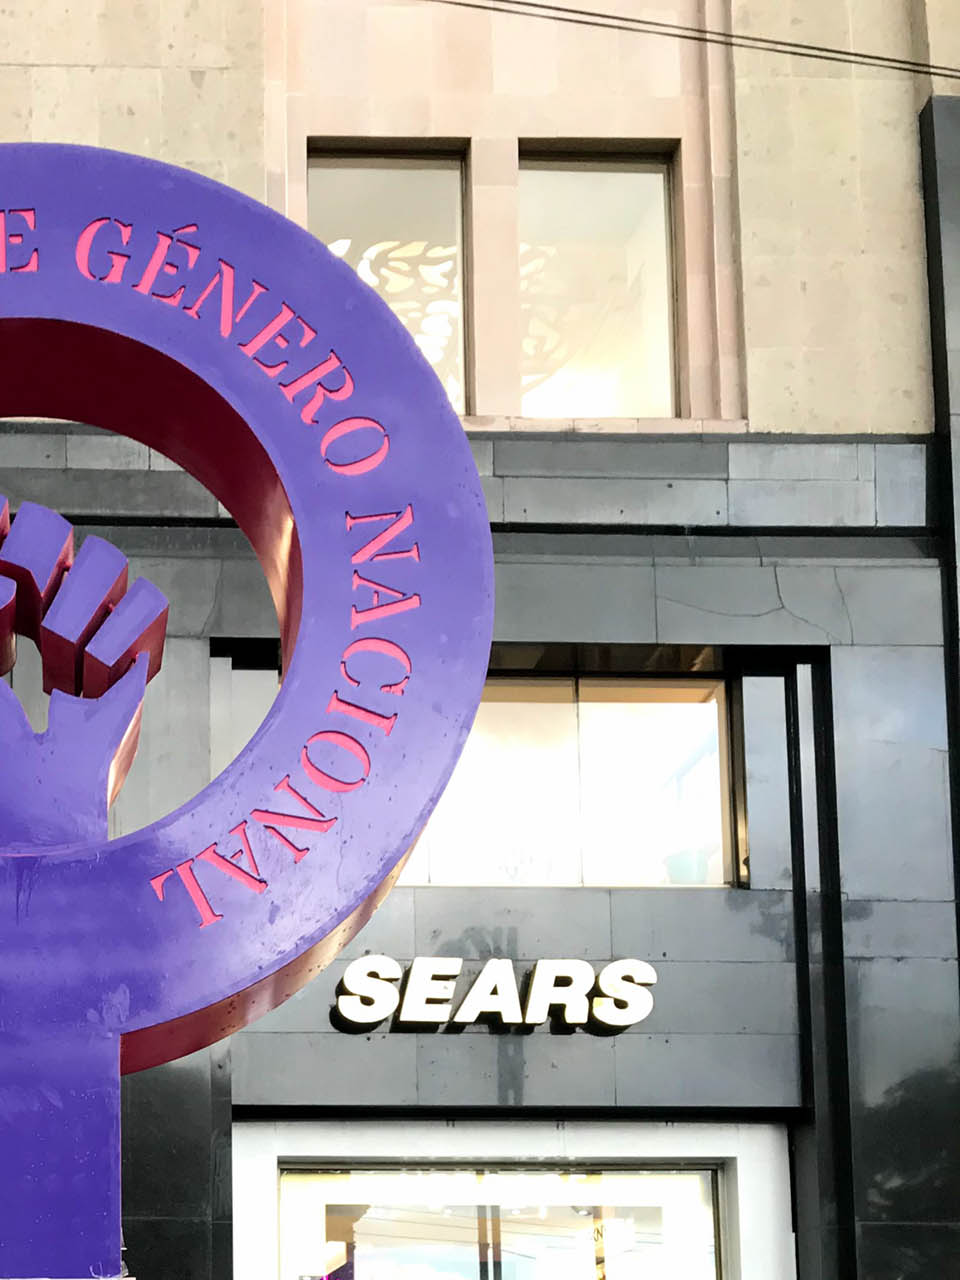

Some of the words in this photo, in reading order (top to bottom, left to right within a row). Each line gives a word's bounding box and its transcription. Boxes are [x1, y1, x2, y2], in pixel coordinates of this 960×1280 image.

[74, 213, 392, 478] GÉNERO
[150, 502, 423, 931] NACIONAL
[337, 954, 658, 1027] SEARS
